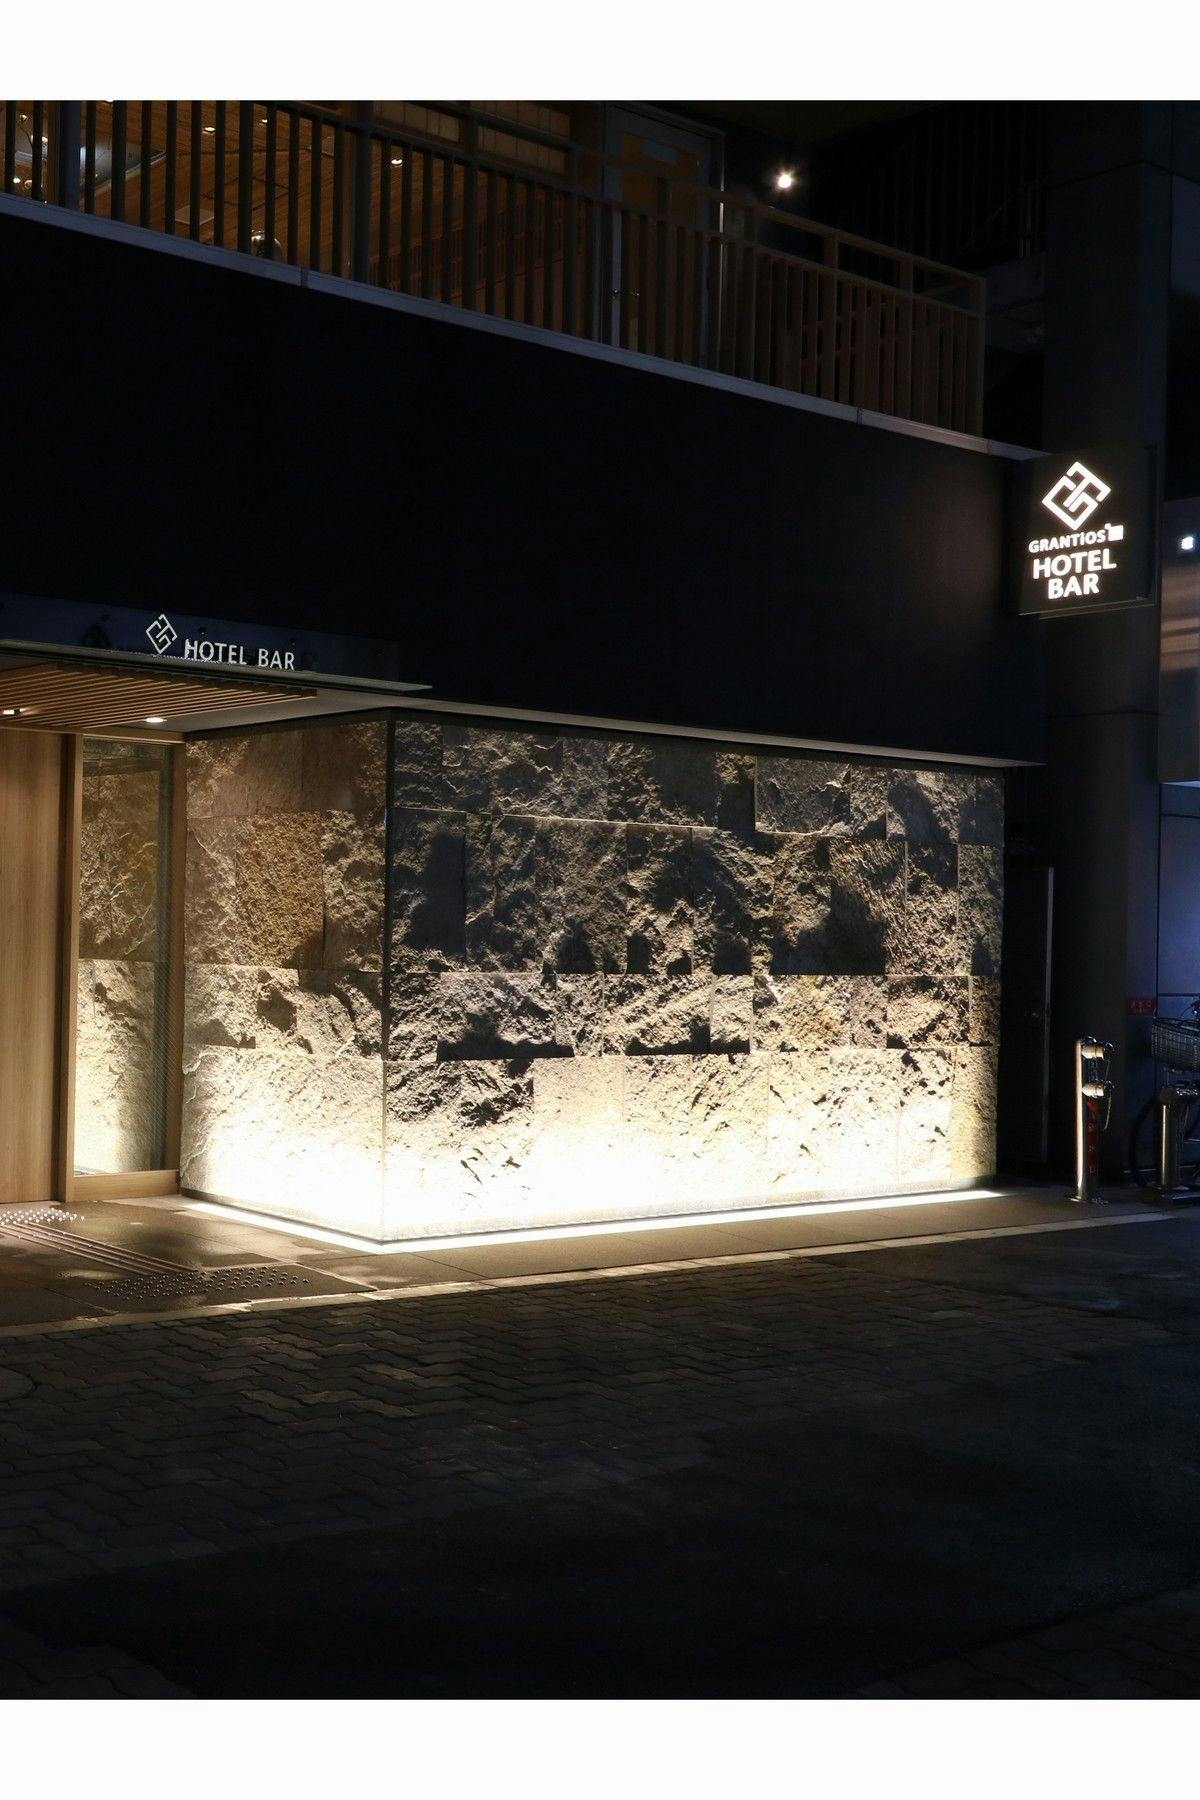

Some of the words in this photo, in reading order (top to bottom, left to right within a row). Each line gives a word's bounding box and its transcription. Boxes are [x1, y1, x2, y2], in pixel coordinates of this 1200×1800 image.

[1028, 530, 1106, 554] GRANTIOS
[1032, 548, 1117, 580] HOTEL
[1047, 574, 1100, 600] BAR
[184, 638, 247, 665] HOTEL
[258, 648, 296, 671] BAR
